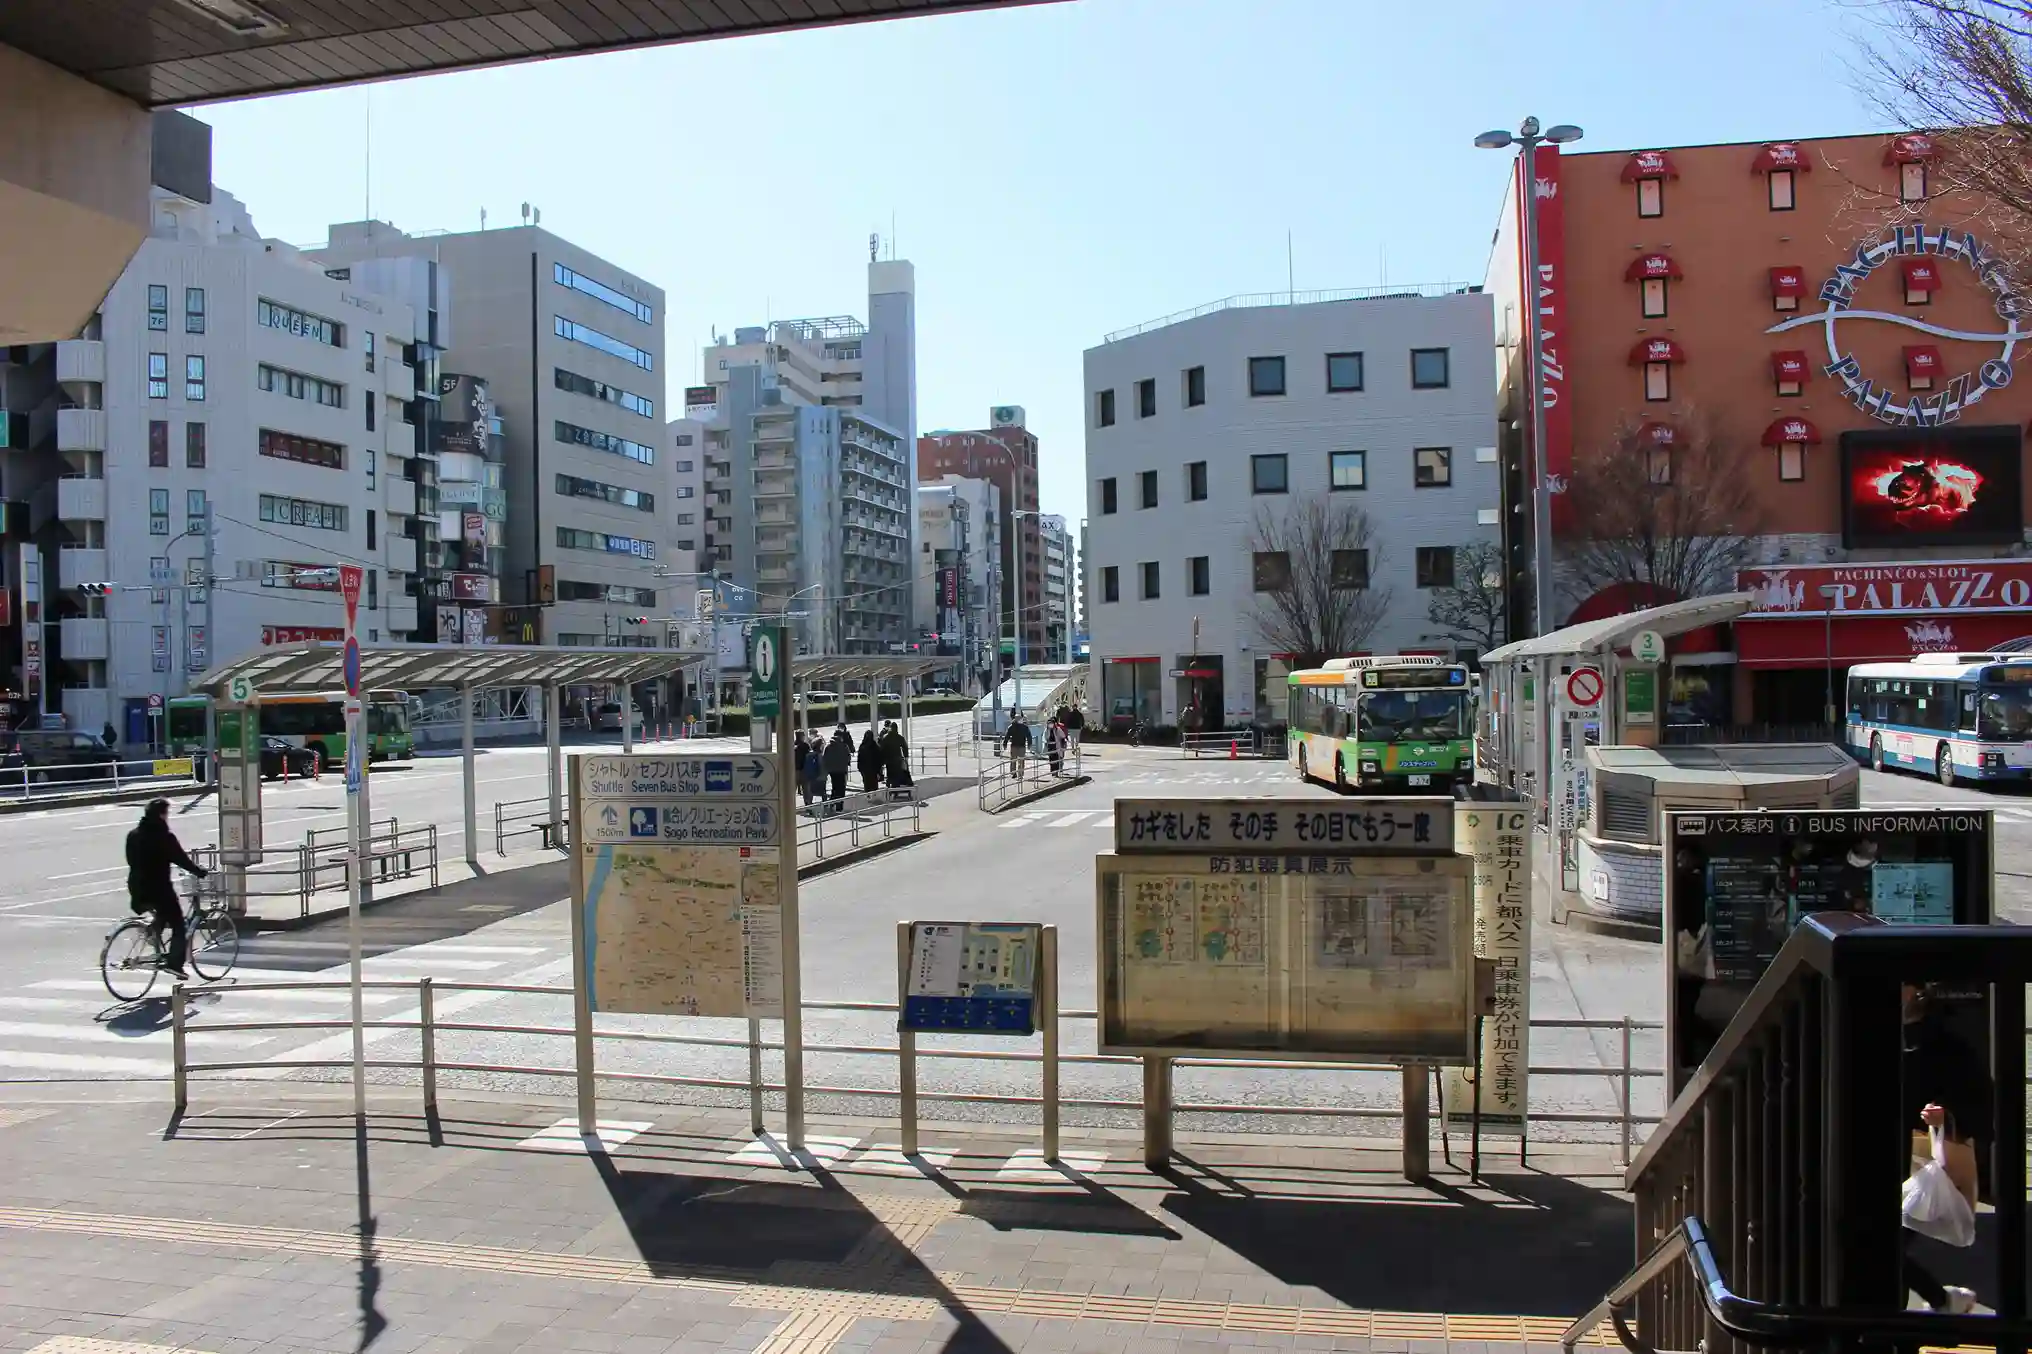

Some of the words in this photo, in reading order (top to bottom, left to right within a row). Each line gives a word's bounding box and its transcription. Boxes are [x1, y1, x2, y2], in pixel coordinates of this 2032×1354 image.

[151, 316, 164, 326] 7F
[273, 308, 320, 338] QUEEN
[1538, 264, 1564, 408] PALAZZO
[442, 379, 456, 391] 5F
[1824, 352, 2013, 427] PALAZZO
[1831, 572, 2030, 611] PALAZZO
[1643, 633, 1653, 649] 3
[233, 678, 248, 699] 5
[592, 780, 624, 793] Shuttle
[632, 781, 659, 793] Seven
[660, 781, 677, 793] Bus
[678, 780, 699, 795] Stop
[740, 782, 763, 793] 20m
[664, 826, 689, 840] Sogo
[691, 826, 742, 839] Recreation
[745, 826, 768, 839] Park
[1130, 812, 1212, 842] カギをした
[1229, 812, 1279, 841] その手
[1294, 811, 1431, 843] その目でもう一度
[1707, 817, 1775, 834] バス案内
[1809, 818, 1847, 833] BUS
[1853, 816, 1983, 832] INFORMATION
